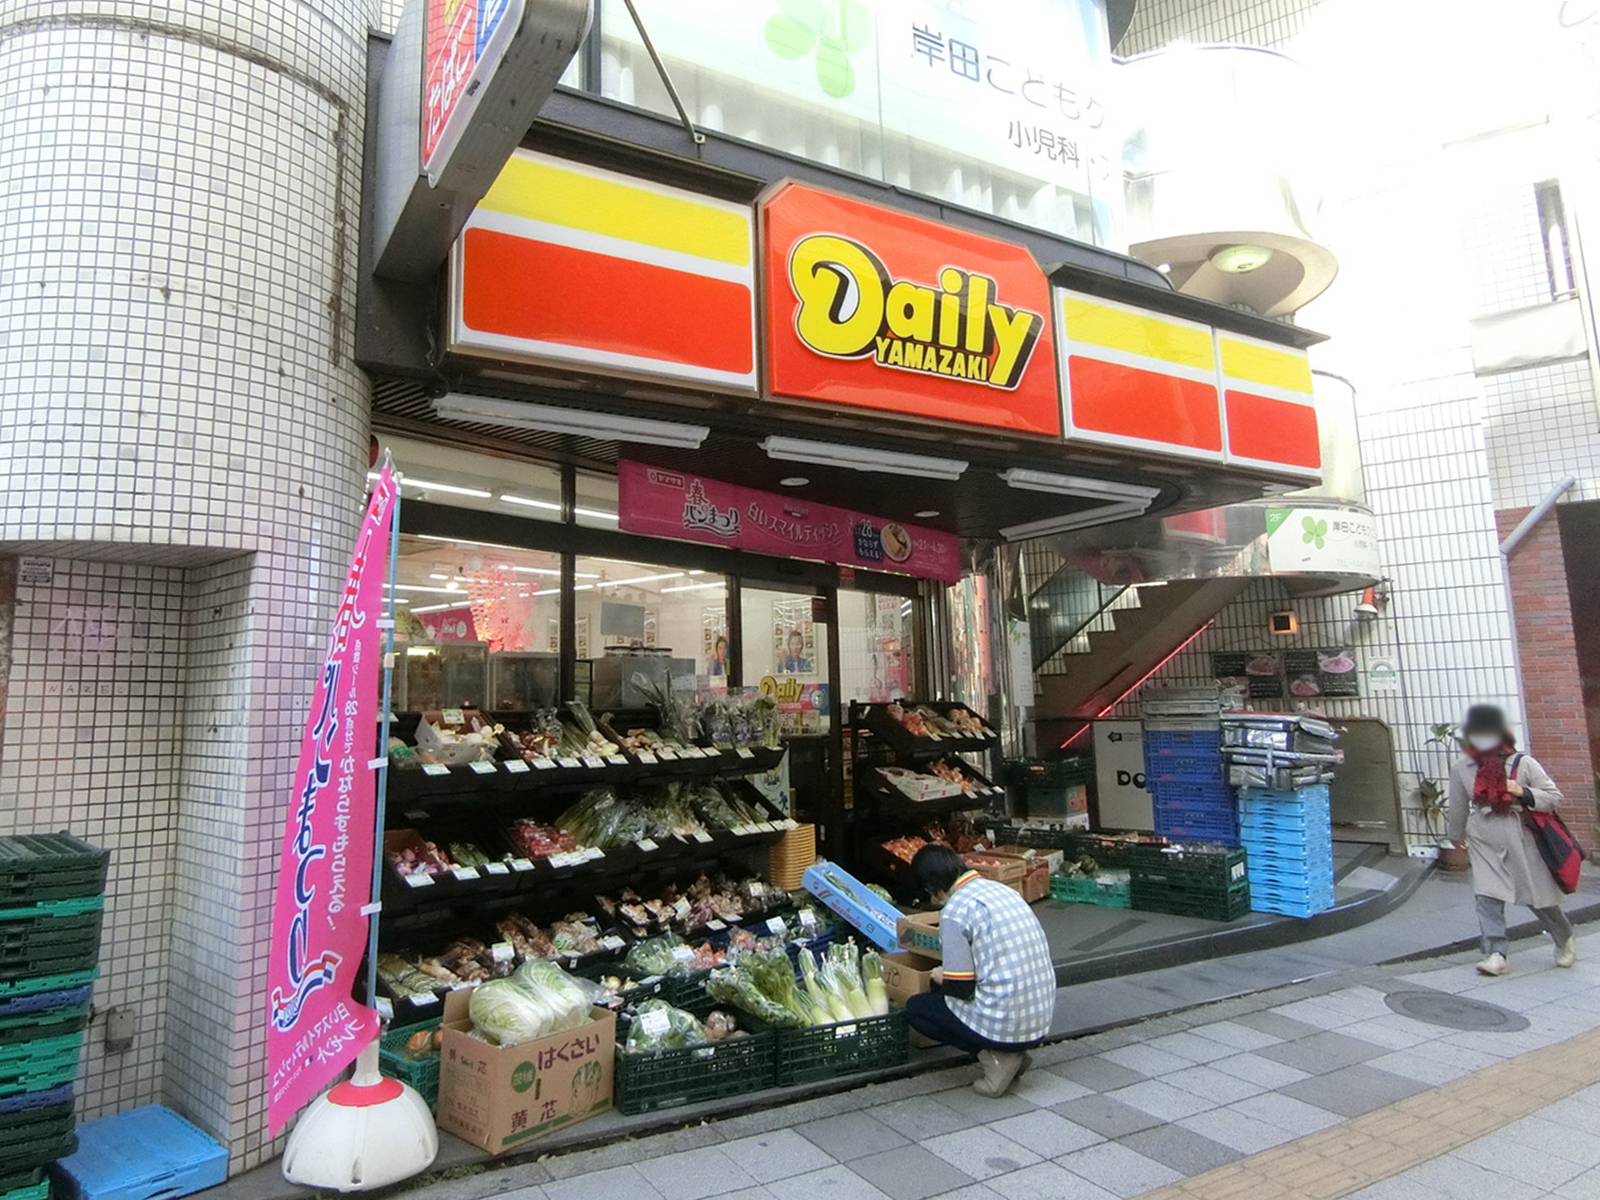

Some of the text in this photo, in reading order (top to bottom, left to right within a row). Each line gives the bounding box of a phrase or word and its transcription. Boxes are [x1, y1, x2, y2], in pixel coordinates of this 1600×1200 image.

[790, 233, 1045, 391] Daily
[874, 336, 991, 383] YAMAZAKI
[684, 503, 740, 528] パンまつり
[860, 518, 874, 538] 28
[1269, 513, 1282, 522] 2F
[760, 676, 805, 703] Daily
[537, 1033, 601, 1071] はくさい
[511, 1108, 529, 1134] 黄
[540, 1099, 558, 1123] 芯
